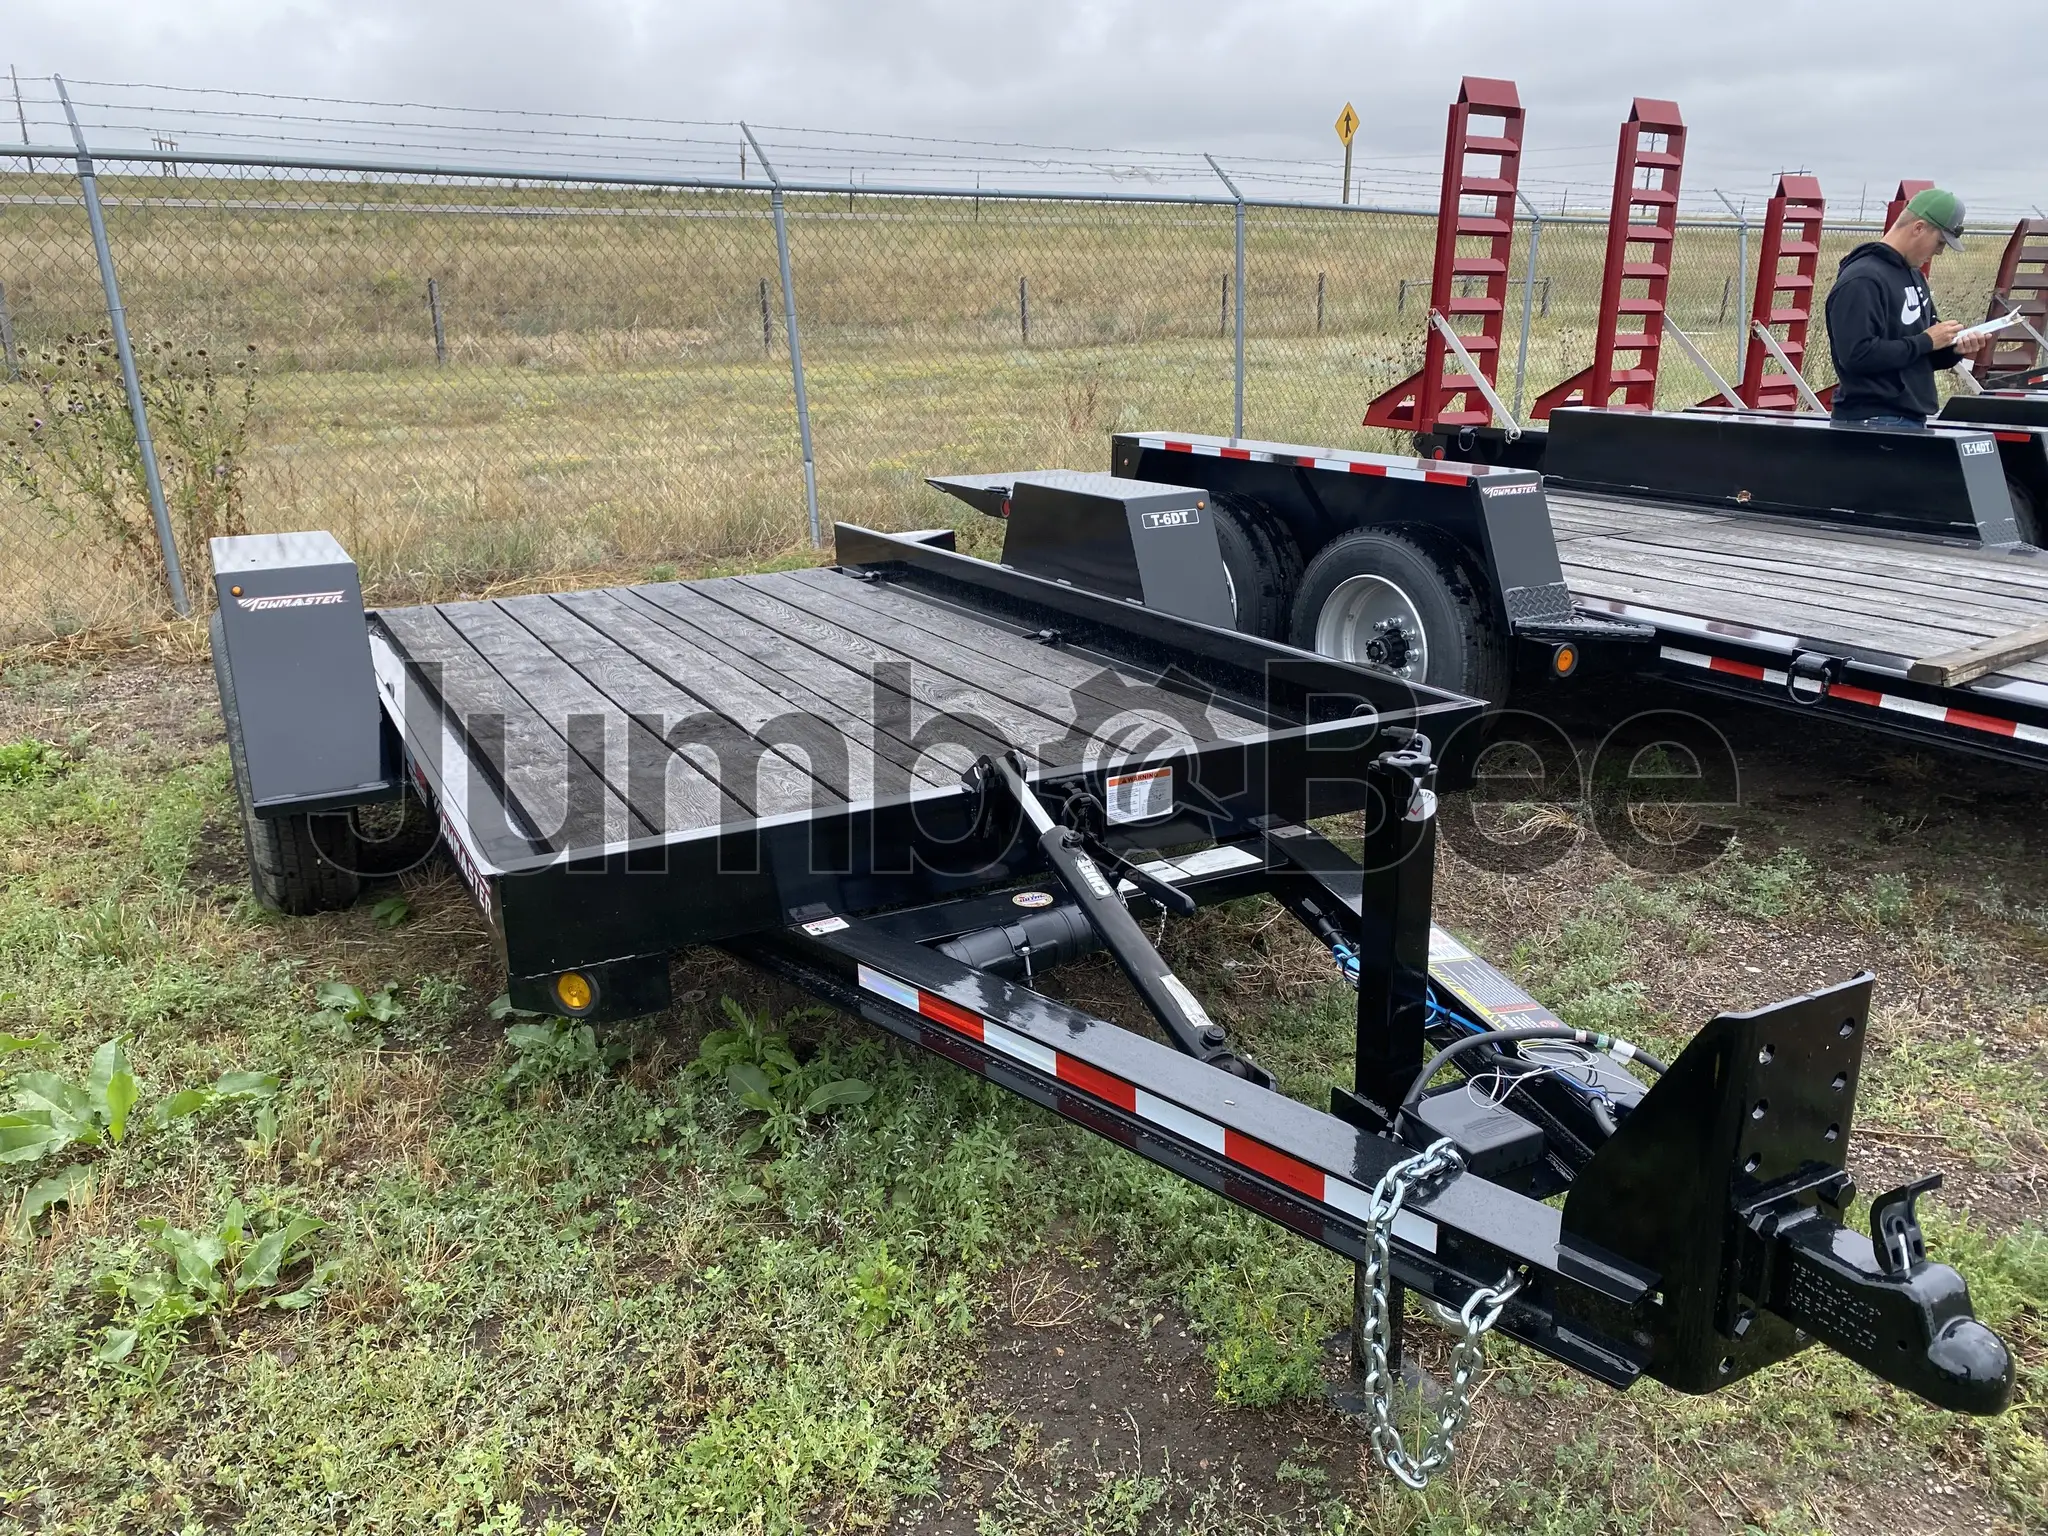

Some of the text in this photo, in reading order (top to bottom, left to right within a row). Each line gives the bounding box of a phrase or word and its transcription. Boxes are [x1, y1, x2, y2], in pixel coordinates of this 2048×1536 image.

[1482, 483, 1538, 499] TOWMASTER
[1151, 511, 1188, 526] T-6DT
[237, 589, 346, 612] TOWMASTER
[1127, 772, 1159, 784] WARNING
